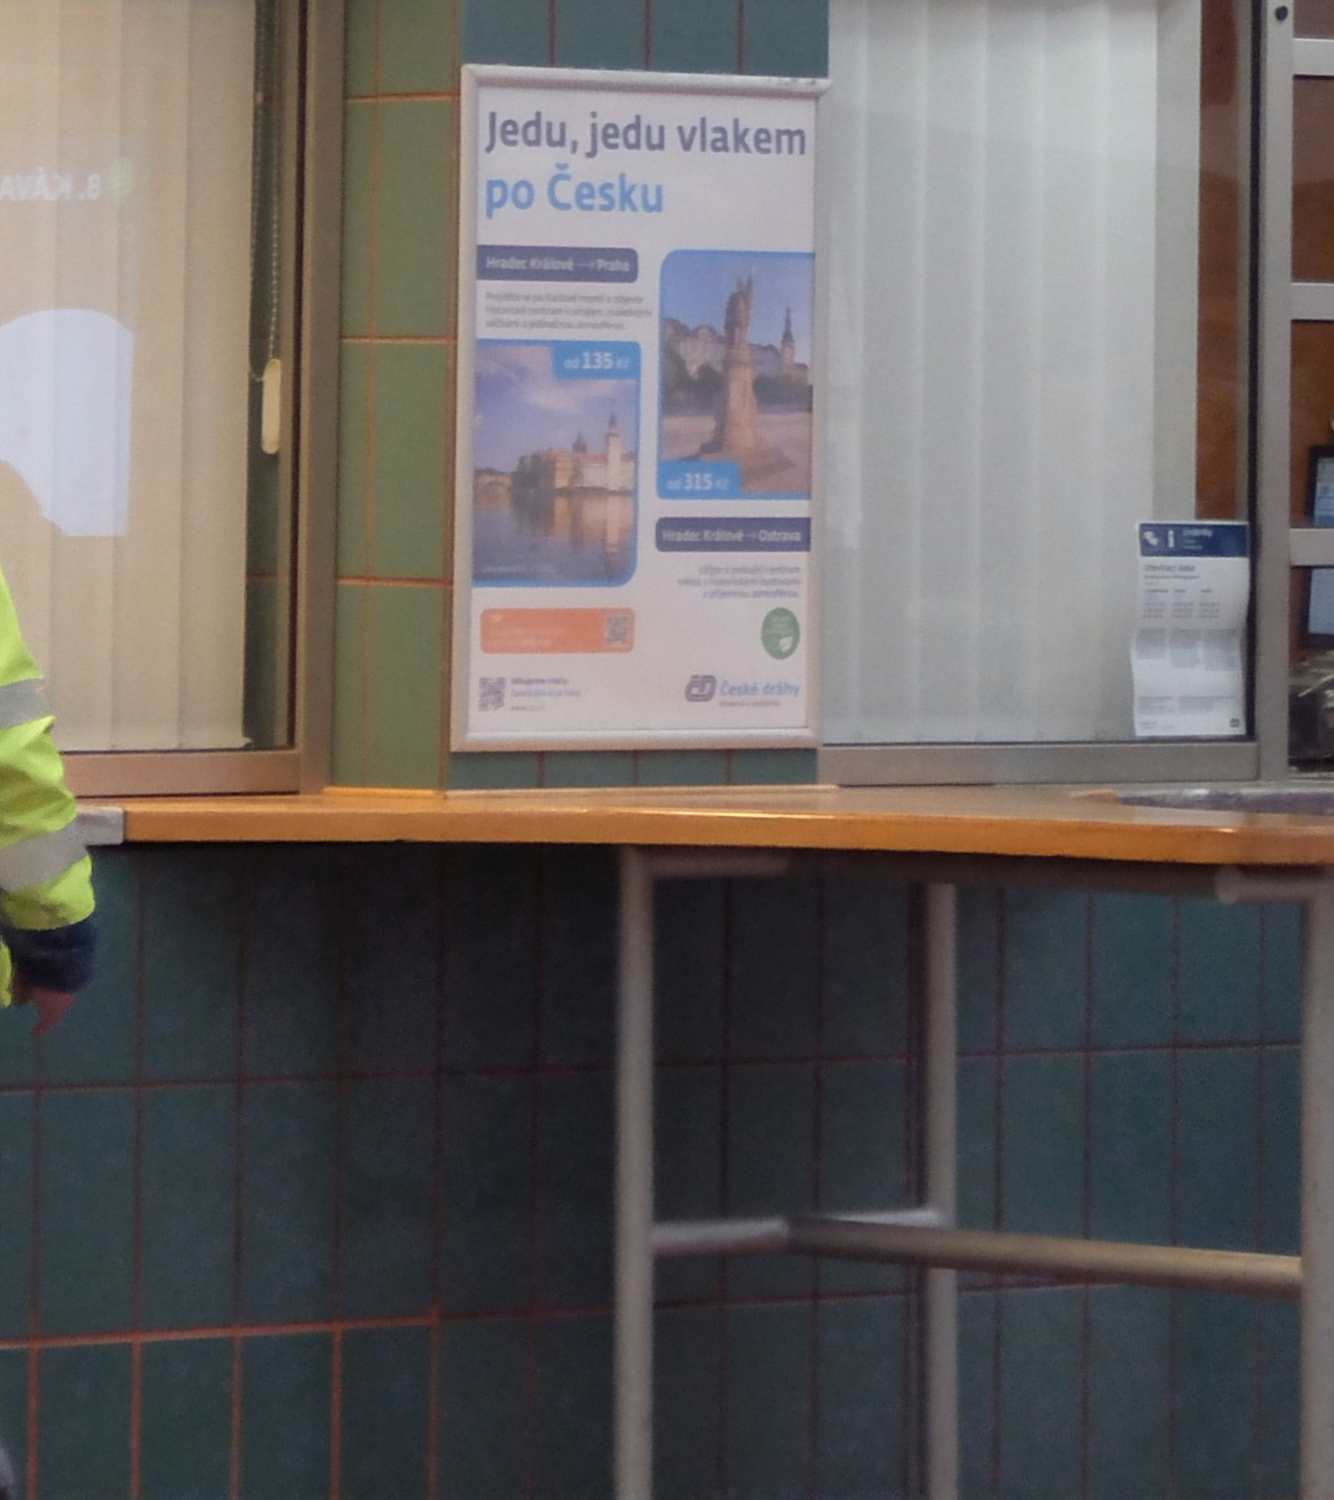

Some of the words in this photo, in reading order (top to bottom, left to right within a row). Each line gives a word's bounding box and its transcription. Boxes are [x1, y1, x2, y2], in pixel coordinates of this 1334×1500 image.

[484, 110, 579, 155] Jedu,
[584, 110, 666, 159] jedu
[676, 116, 806, 156] vlakem
[485, 176, 536, 219] po
[546, 162, 665, 213] Česku
[582, 352, 613, 369] 135
[684, 473, 712, 490] 315
